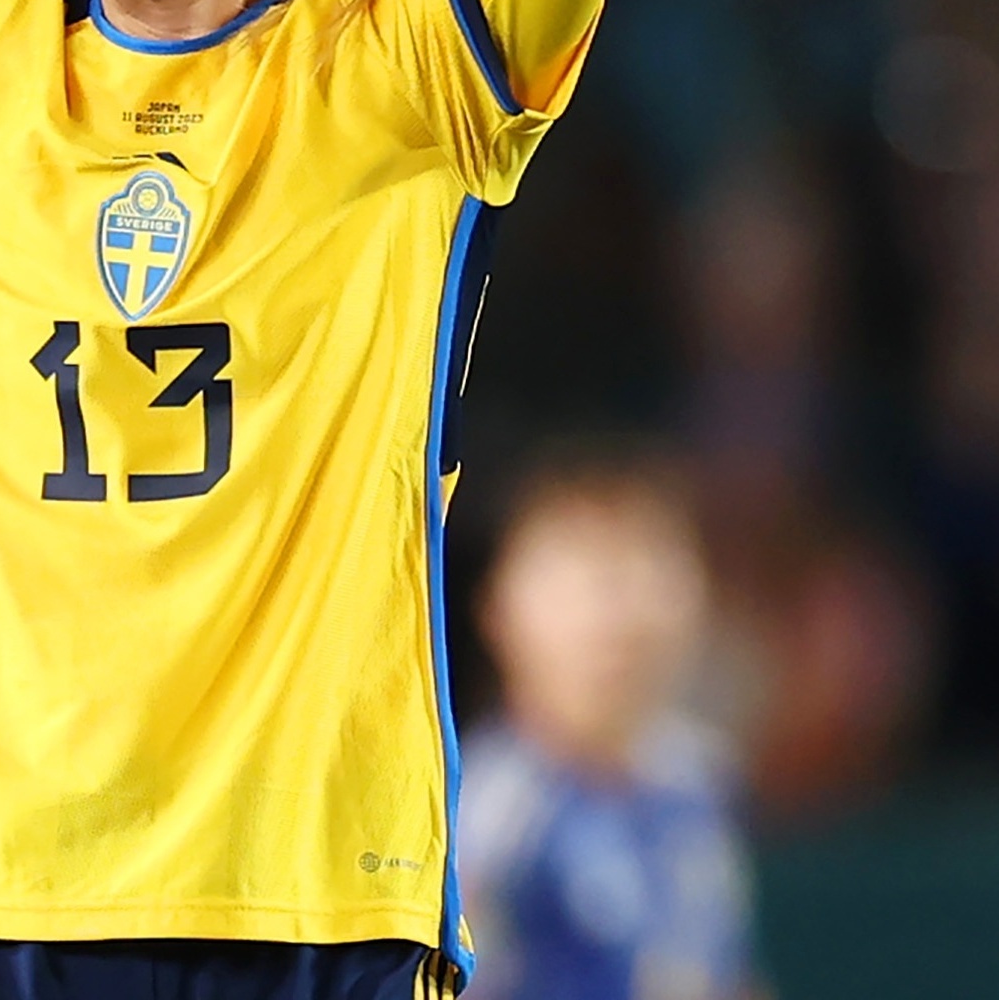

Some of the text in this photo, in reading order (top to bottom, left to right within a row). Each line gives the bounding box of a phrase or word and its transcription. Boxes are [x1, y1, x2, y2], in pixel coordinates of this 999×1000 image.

[147, 102, 180, 113] JAPAN
[135, 112, 174, 124] AUGUST
[115, 217, 173, 232] SVERIGE
[29, 320, 233, 502] 13
